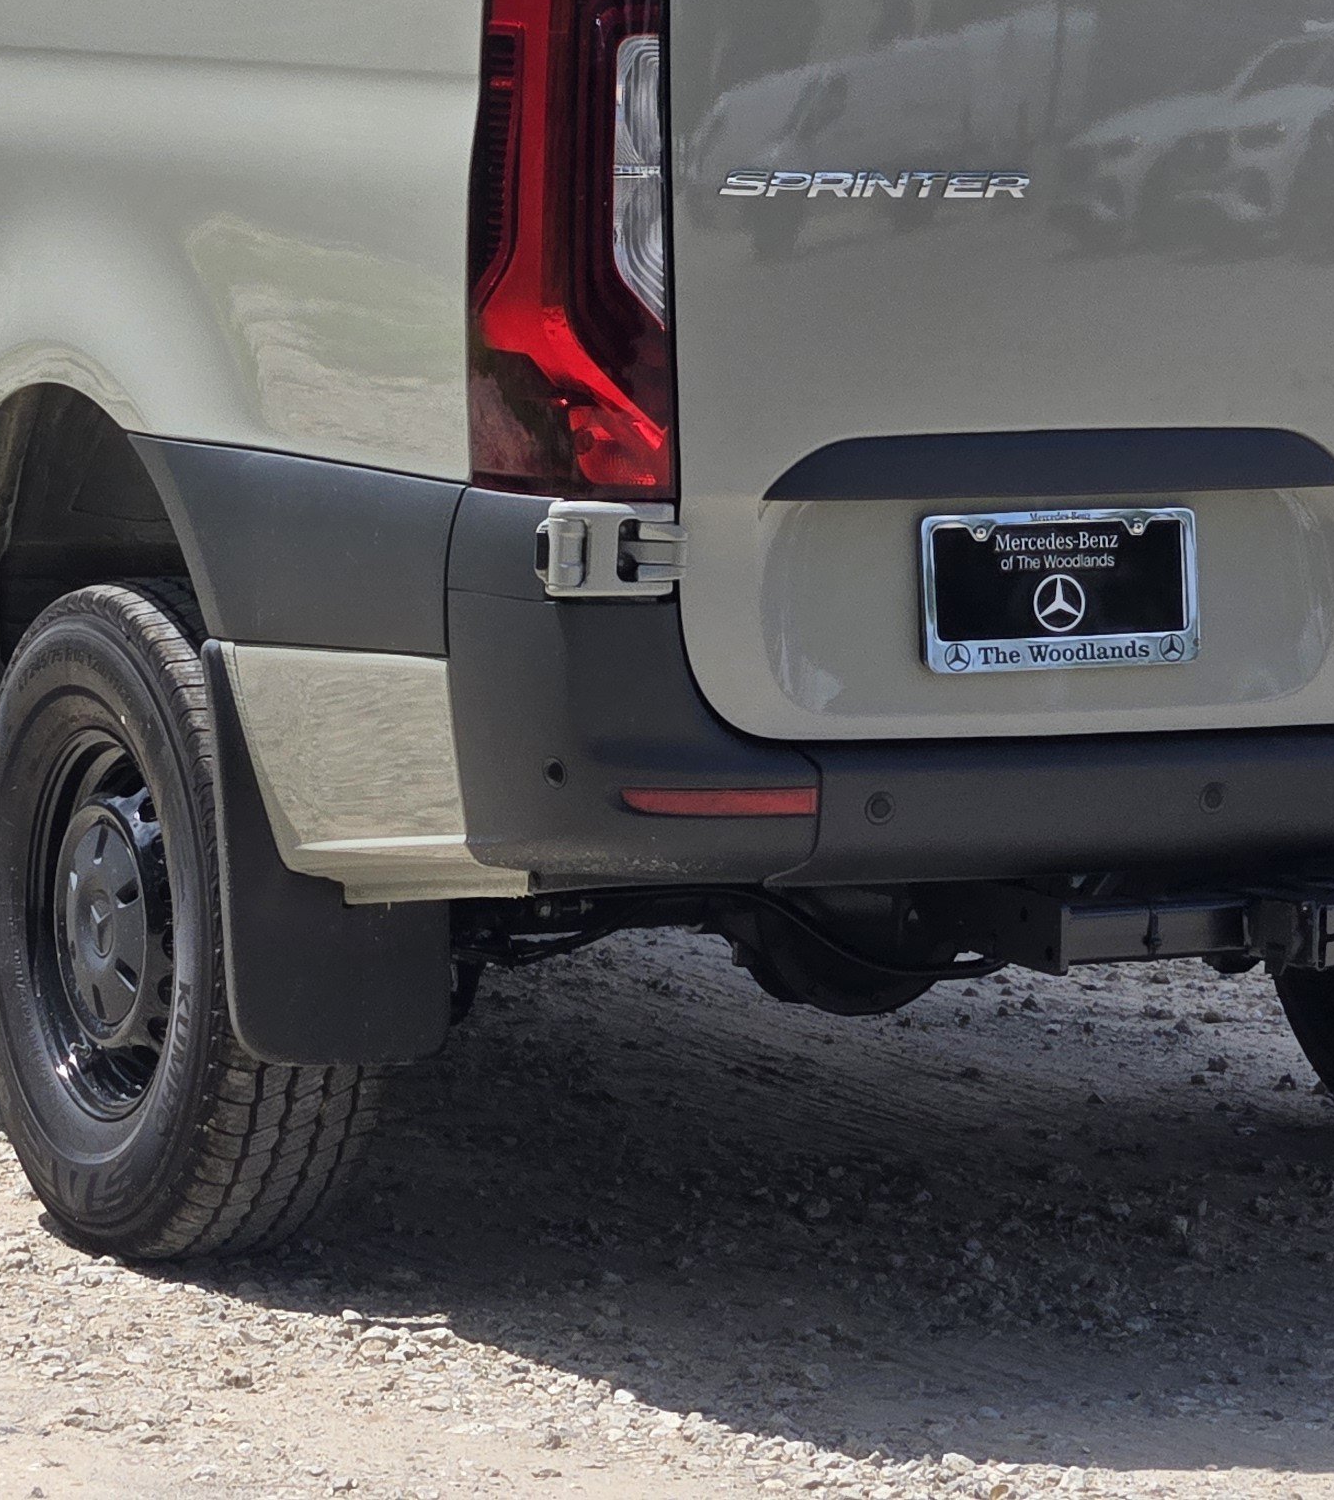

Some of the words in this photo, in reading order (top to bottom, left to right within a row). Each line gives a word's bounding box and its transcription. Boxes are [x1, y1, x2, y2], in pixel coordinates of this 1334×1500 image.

[719, 170, 1030, 199] SPRINTER
[994, 531, 1119, 552] Mercedes-Benz
[1000, 555, 1014, 570] of
[1016, 555, 1041, 569] The
[1044, 553, 1115, 569] Woodlands
[978, 646, 1021, 665] The
[1028, 640, 1150, 663] Woodlands
